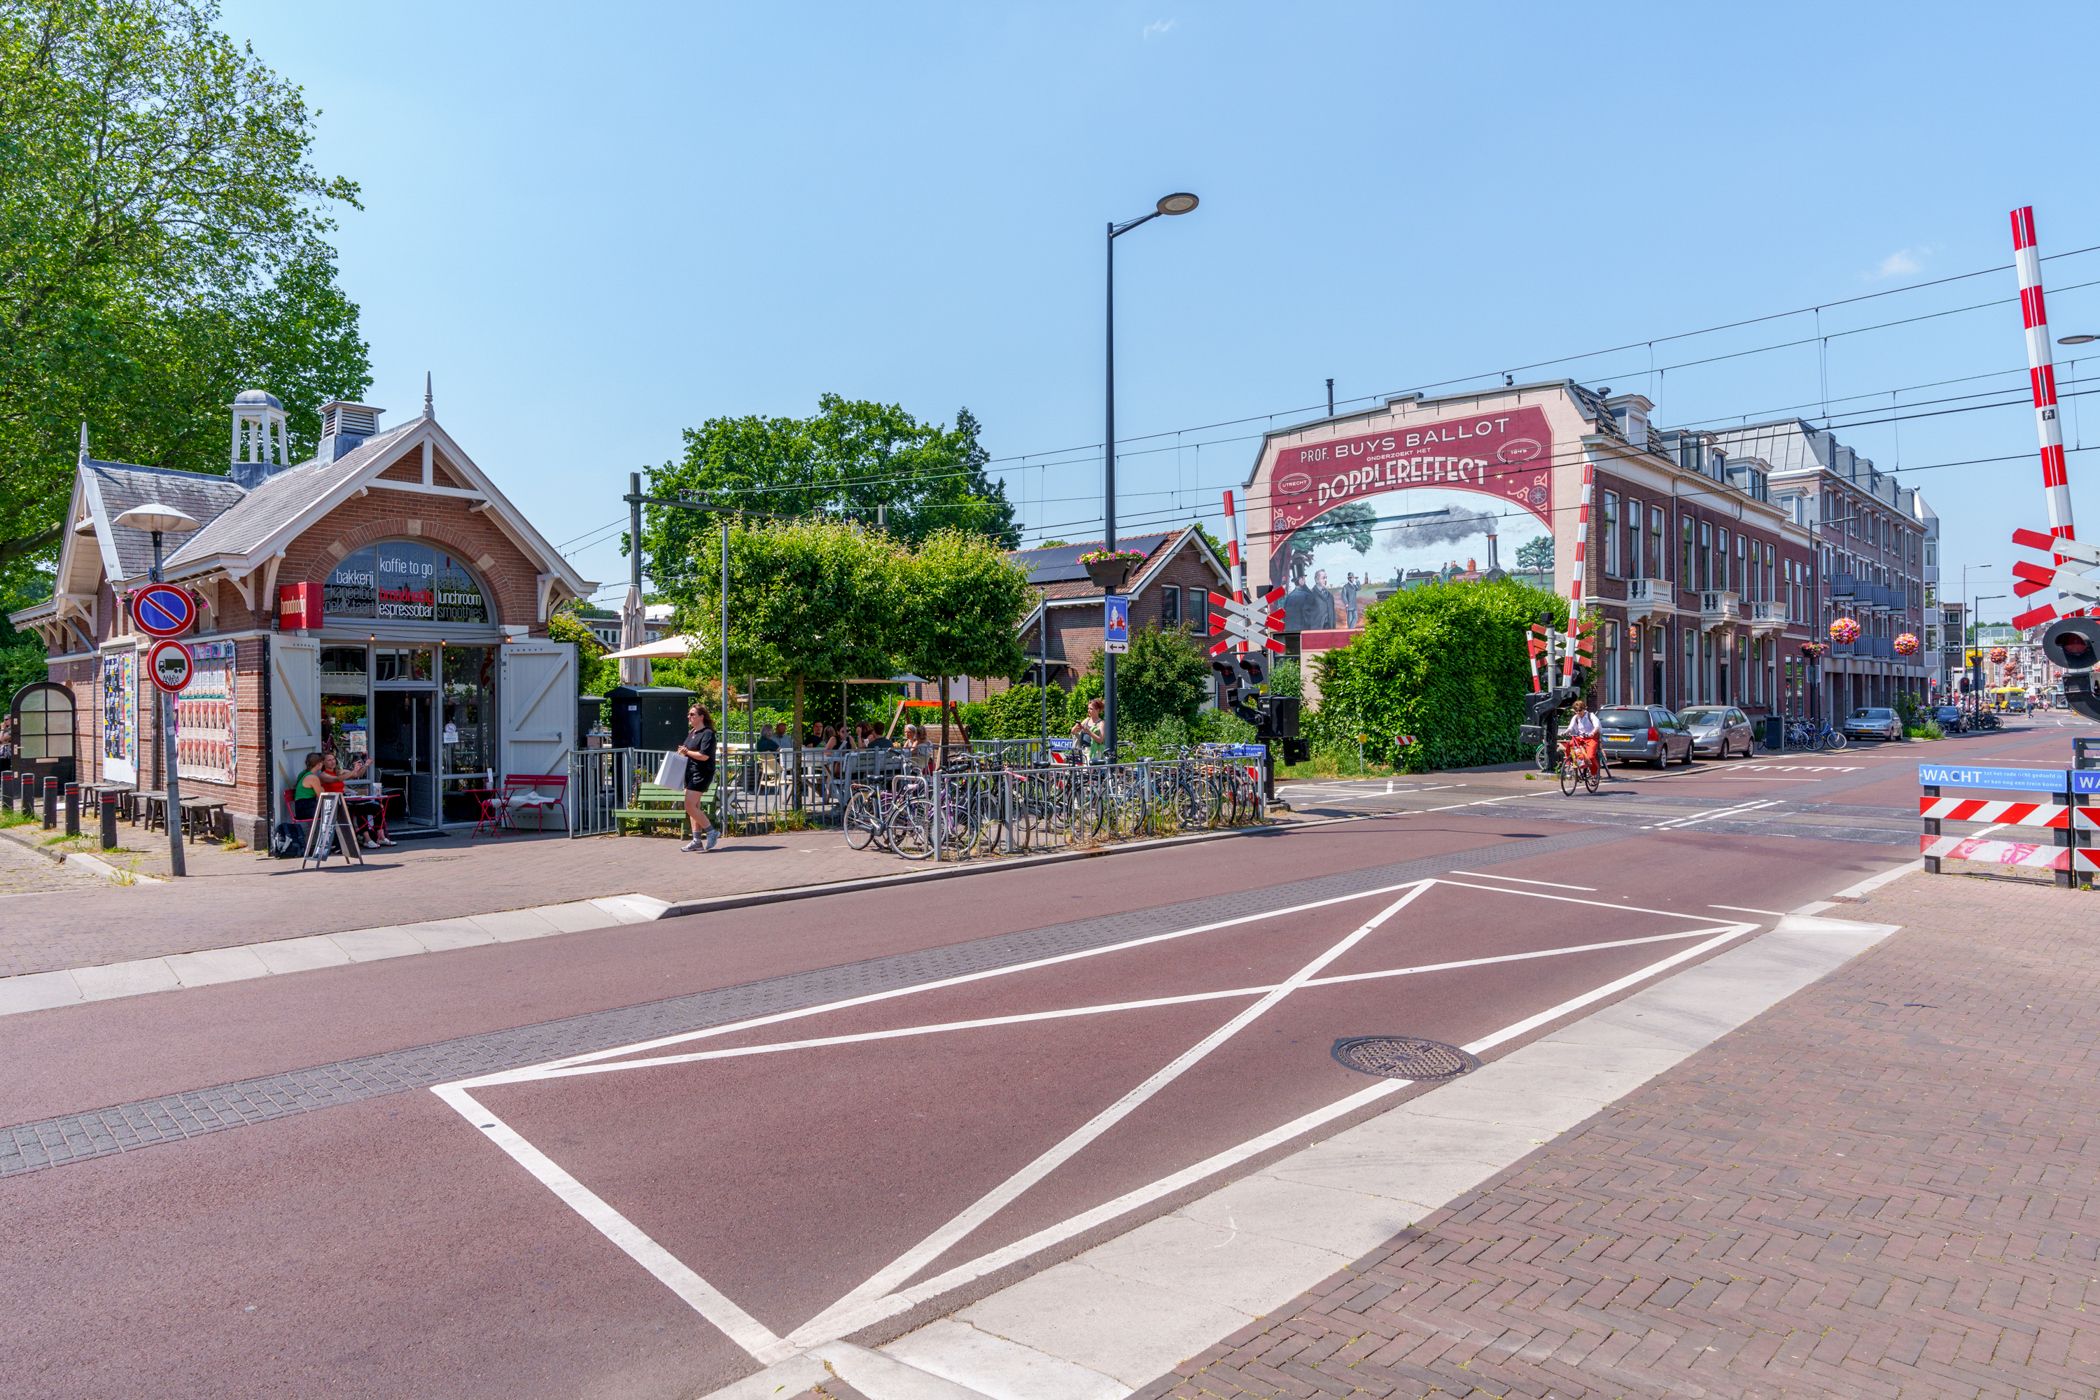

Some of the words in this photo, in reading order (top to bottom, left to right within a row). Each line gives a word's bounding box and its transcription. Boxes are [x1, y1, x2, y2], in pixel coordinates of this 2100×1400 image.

[1300, 447, 1330, 464] PROF.
[1335, 438, 1396, 459] BUYS
[1406, 417, 1510, 448] BALLOT
[1366, 450, 1414, 463] ONDERZOEKT
[1416, 447, 1432, 456] HET
[1282, 479, 1308, 488] UTRECHT
[1318, 456, 1489, 507] DOPPLEREFFECT
[379, 557, 407, 574] koffie
[409, 561, 419, 575] to
[421, 564, 433, 579] go
[336, 568, 374, 589] bakkerij
[437, 589, 482, 607] lunchroom
[379, 602, 433, 619] espressobar
[437, 605, 484, 619] smoothies
[1923, 768, 1983, 784] WACHT
